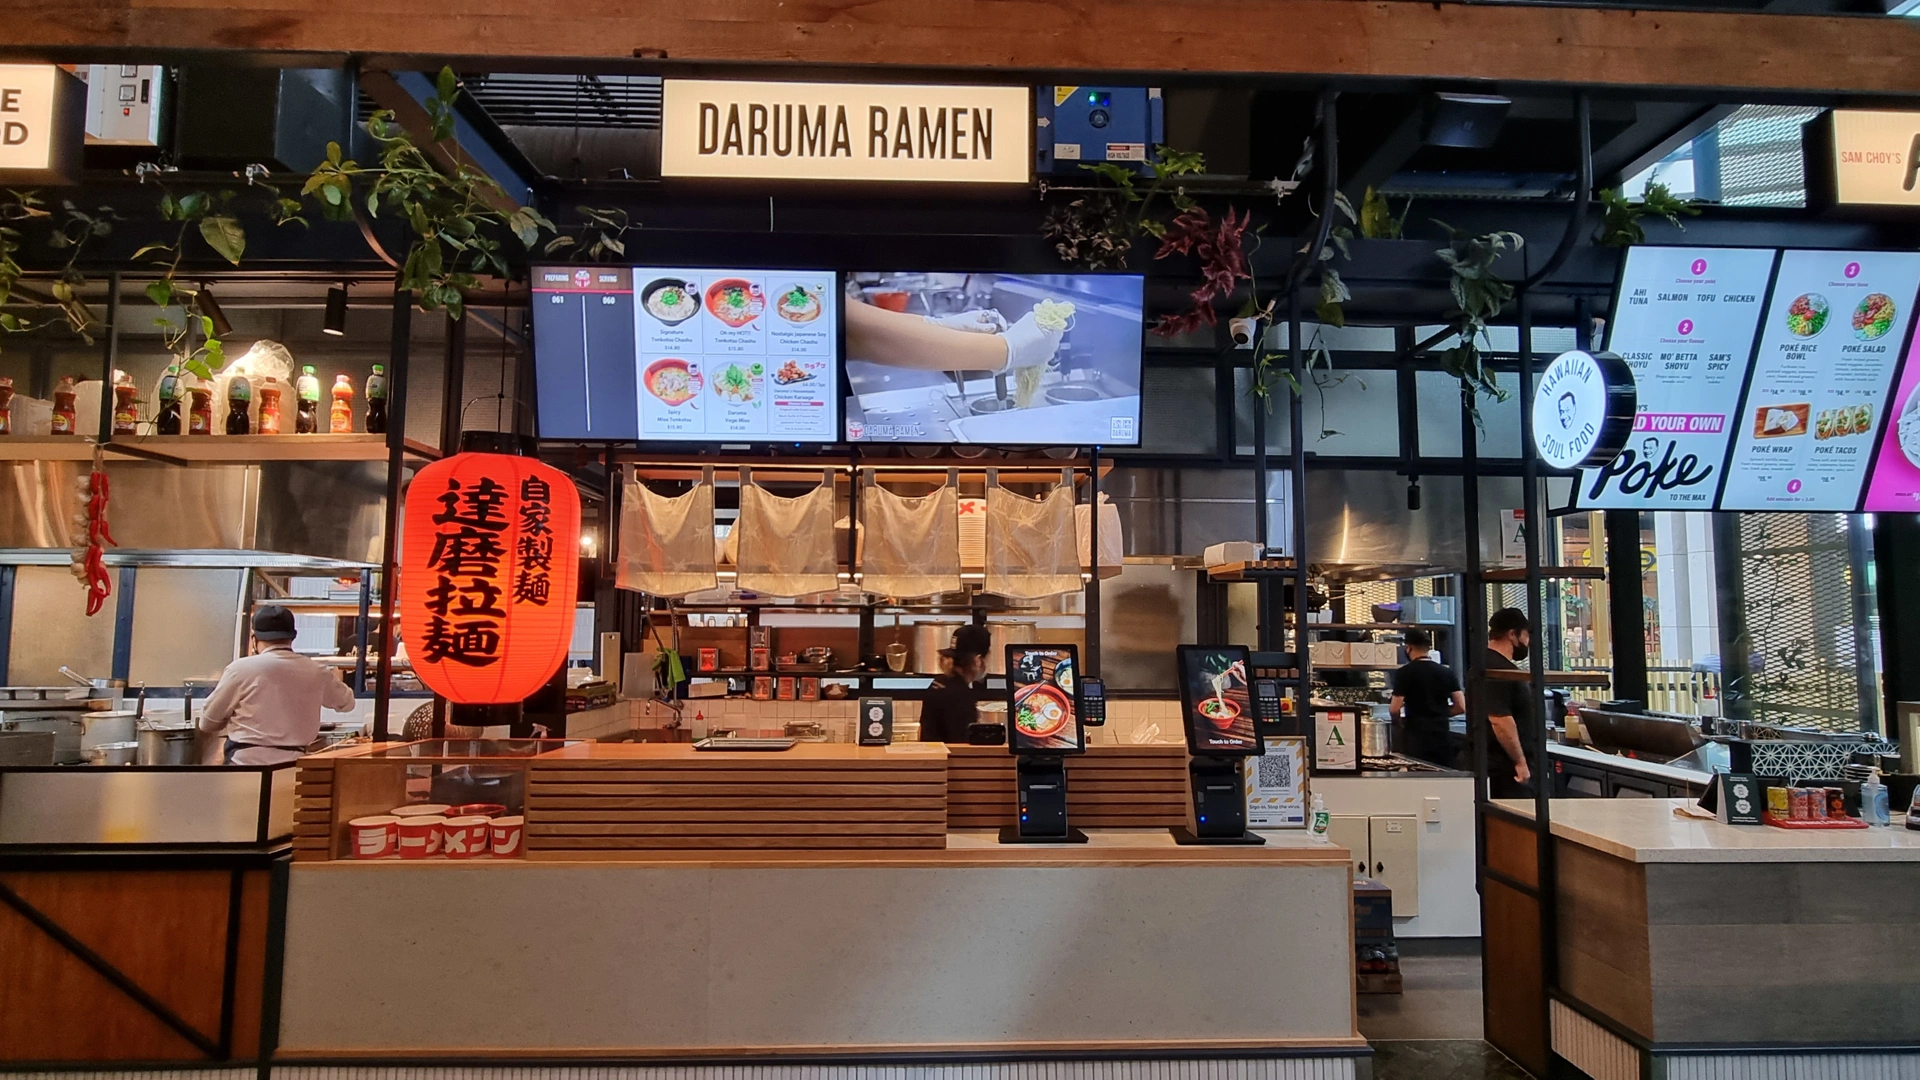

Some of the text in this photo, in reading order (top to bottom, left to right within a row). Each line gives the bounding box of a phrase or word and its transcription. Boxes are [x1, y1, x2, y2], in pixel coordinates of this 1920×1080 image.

[698, 101, 993, 160] DARUMA RAMEN
[1841, 151, 1902, 164] SAM CHOY'S
[1633, 288, 1647, 296] AHI
[551, 295, 564, 304] 061
[602, 296, 616, 305] 060
[1629, 297, 1648, 305] TUNA
[1657, 293, 1689, 301] SALMON
[1697, 294, 1716, 302] TOFU
[1723, 295, 1756, 303] CHICKEN
[1779, 343, 1818, 352] POKÉ RICE
[1841, 343, 1886, 353] POKÉ SALAD
[1622, 352, 1653, 360] CLASSIC
[1675, 353, 1698, 361] BETTA
[1708, 353, 1732, 361] SAM'S
[1785, 352, 1807, 360] BOWL
[1664, 362, 1689, 370] SHOYU
[1707, 362, 1729, 371] SPICY
[1541, 359, 1593, 397] HAWAIIAN
[1650, 416, 1687, 431] YOUR
[1689, 417, 1722, 431] OWN
[864, 425, 920, 437] DARUMA RAMEN
[1542, 422, 1595, 460] SOUL FOOD
[1751, 445, 1793, 454] POKÉ WRAP
[1814, 445, 1834, 454] POKÉ
[1325, 724, 1345, 745] A
